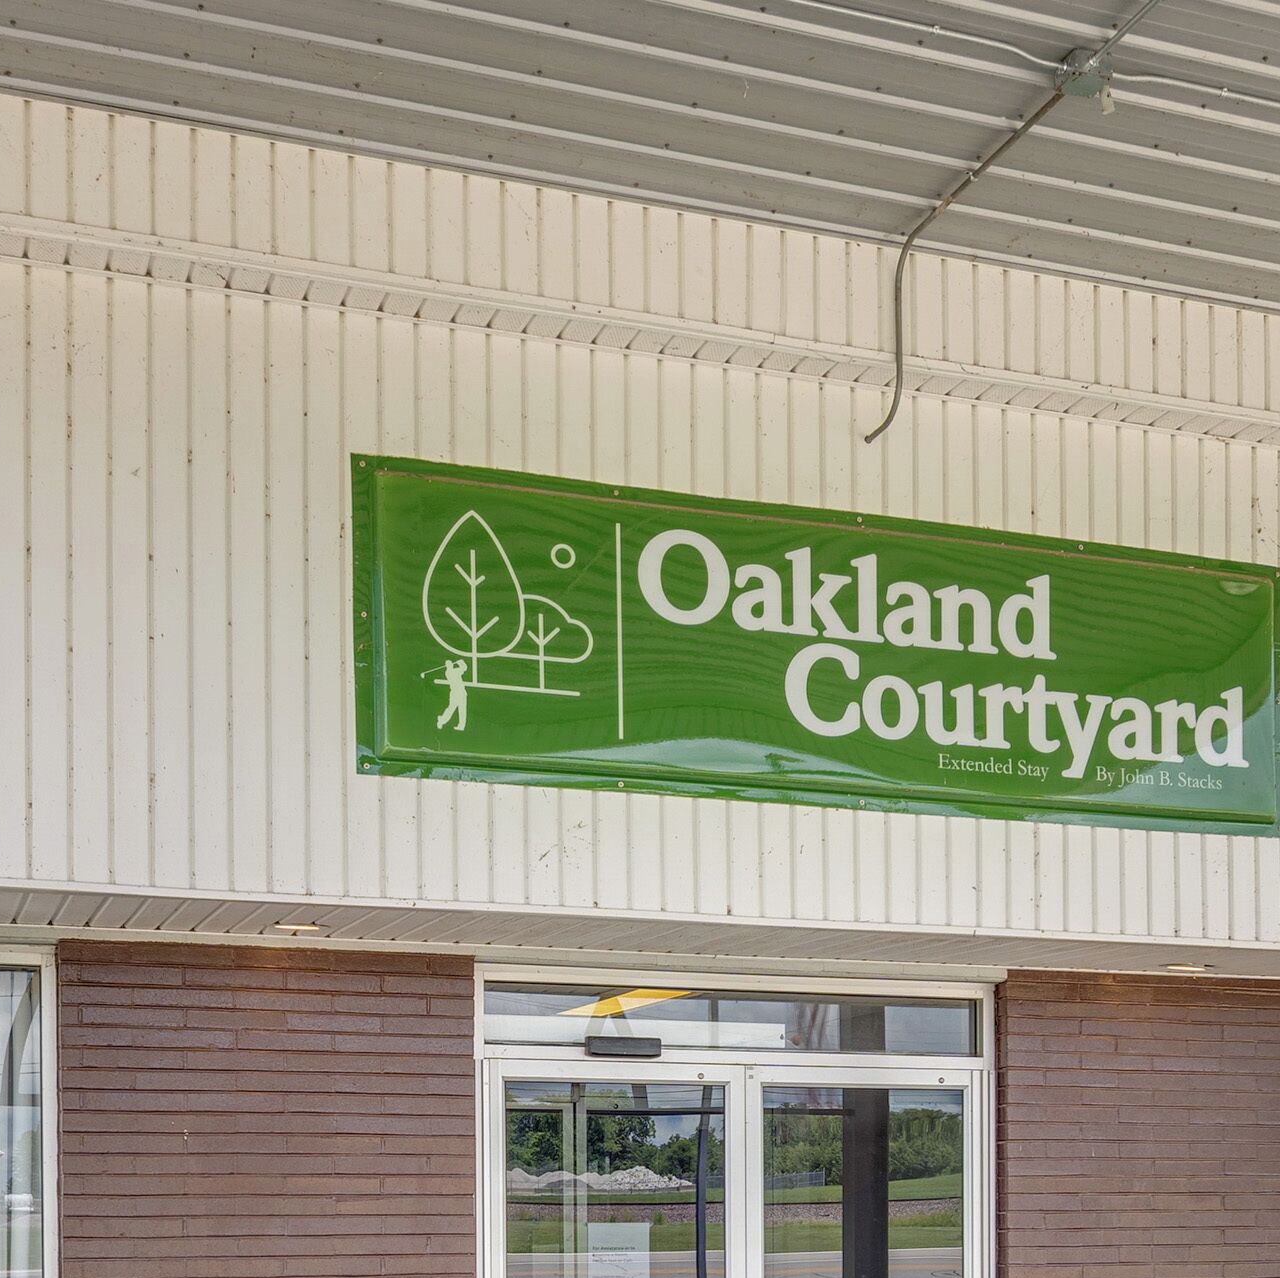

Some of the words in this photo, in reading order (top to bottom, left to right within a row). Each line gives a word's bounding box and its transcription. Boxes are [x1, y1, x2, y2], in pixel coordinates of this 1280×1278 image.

[638, 529, 1056, 660] Oakland
[785, 643, 1249, 778] Courtyard
[938, 753, 1012, 775] Extended
[1017, 761, 1049, 782] Stay
[1095, 766, 1115, 787] By
[1119, 768, 1154, 787] John
[1158, 772, 1173, 787] B.
[1177, 774, 1223, 790] Stacks
